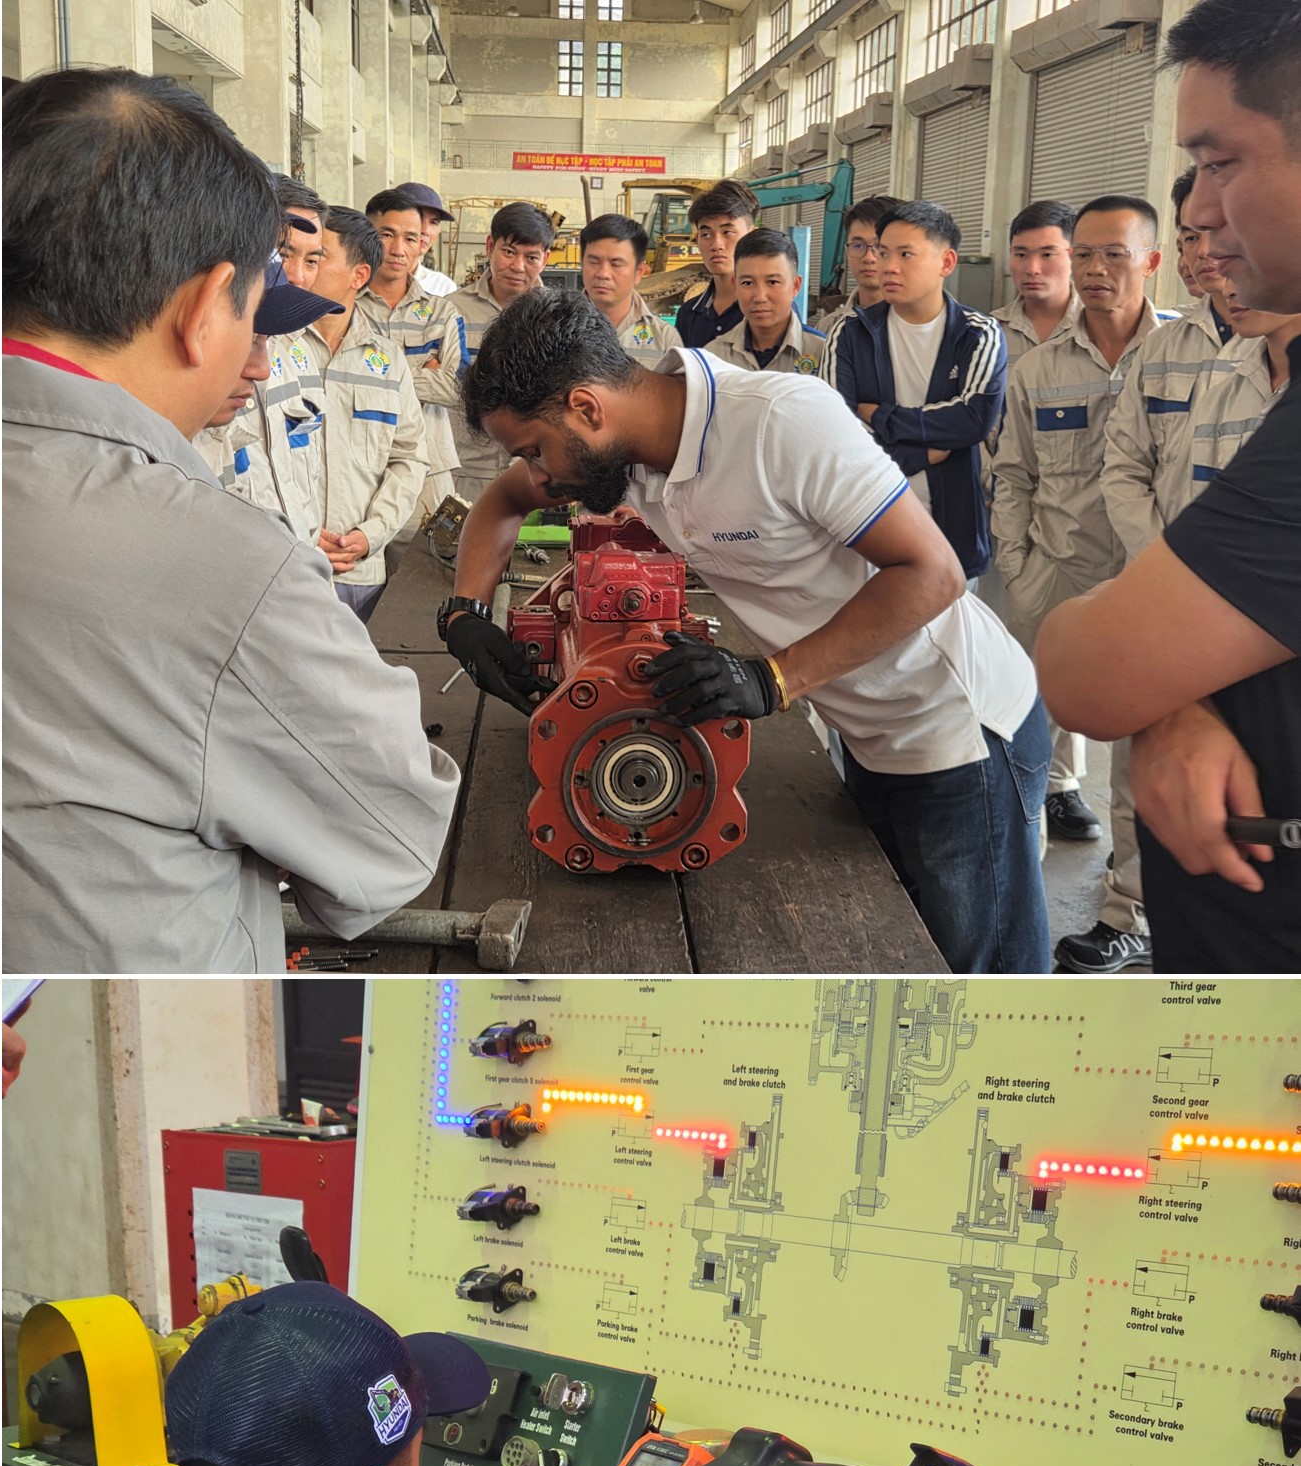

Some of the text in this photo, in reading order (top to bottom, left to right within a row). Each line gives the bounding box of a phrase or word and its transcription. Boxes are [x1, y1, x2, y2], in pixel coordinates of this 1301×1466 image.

[712, 530, 760, 542] HYUNDAI
[1169, 981, 1216, 993] Third gear
[1161, 996, 1222, 1005] control valve
[626, 1065, 654, 1075] First gear
[732, 1064, 779, 1077] Left steering
[620, 1076, 640, 1085] control
[723, 1078, 786, 1089] and brake clutch
[985, 1076, 1050, 1091] Right steering
[1213, 1078, 1220, 1087] P
[977, 1091, 1055, 1103] and brake clutch
[1152, 1095, 1209, 1107] Second gear
[1149, 1109, 1209, 1121] control valve
[615, 1145, 652, 1157] Left steering
[491, 1156, 512, 1166] steering
[514, 1158, 531, 1167] clutch
[532, 1160, 555, 1169] solenoid
[614, 1157, 635, 1166] control
[1201, 1181, 1208, 1190] P
[1138, 1195, 1202, 1211] Right steering
[1139, 1210, 1198, 1223] control valve
[485, 1236, 499, 1245] brake
[501, 1238, 523, 1248] solenoid
[611, 1235, 640, 1247] Left brake
[605, 1245, 644, 1258] control valve
[1189, 1295, 1195, 1304] P
[1130, 1307, 1183, 1322] Right brake
[467, 1314, 529, 1332] Parking brake solenoid
[597, 1319, 638, 1333] Parking brake
[1126, 1321, 1185, 1336] control valve
[598, 1330, 636, 1344] control valve
[1270, 1349, 1296, 1361] Right
[530, 1407, 538, 1417] Air
[1176, 1402, 1183, 1410] P
[563, 1419, 581, 1432] Starter
[1109, 1410, 1184, 1431] Secondary brake
[559, 1433, 577, 1446] Switch
[1116, 1426, 1174, 1442] control valve
